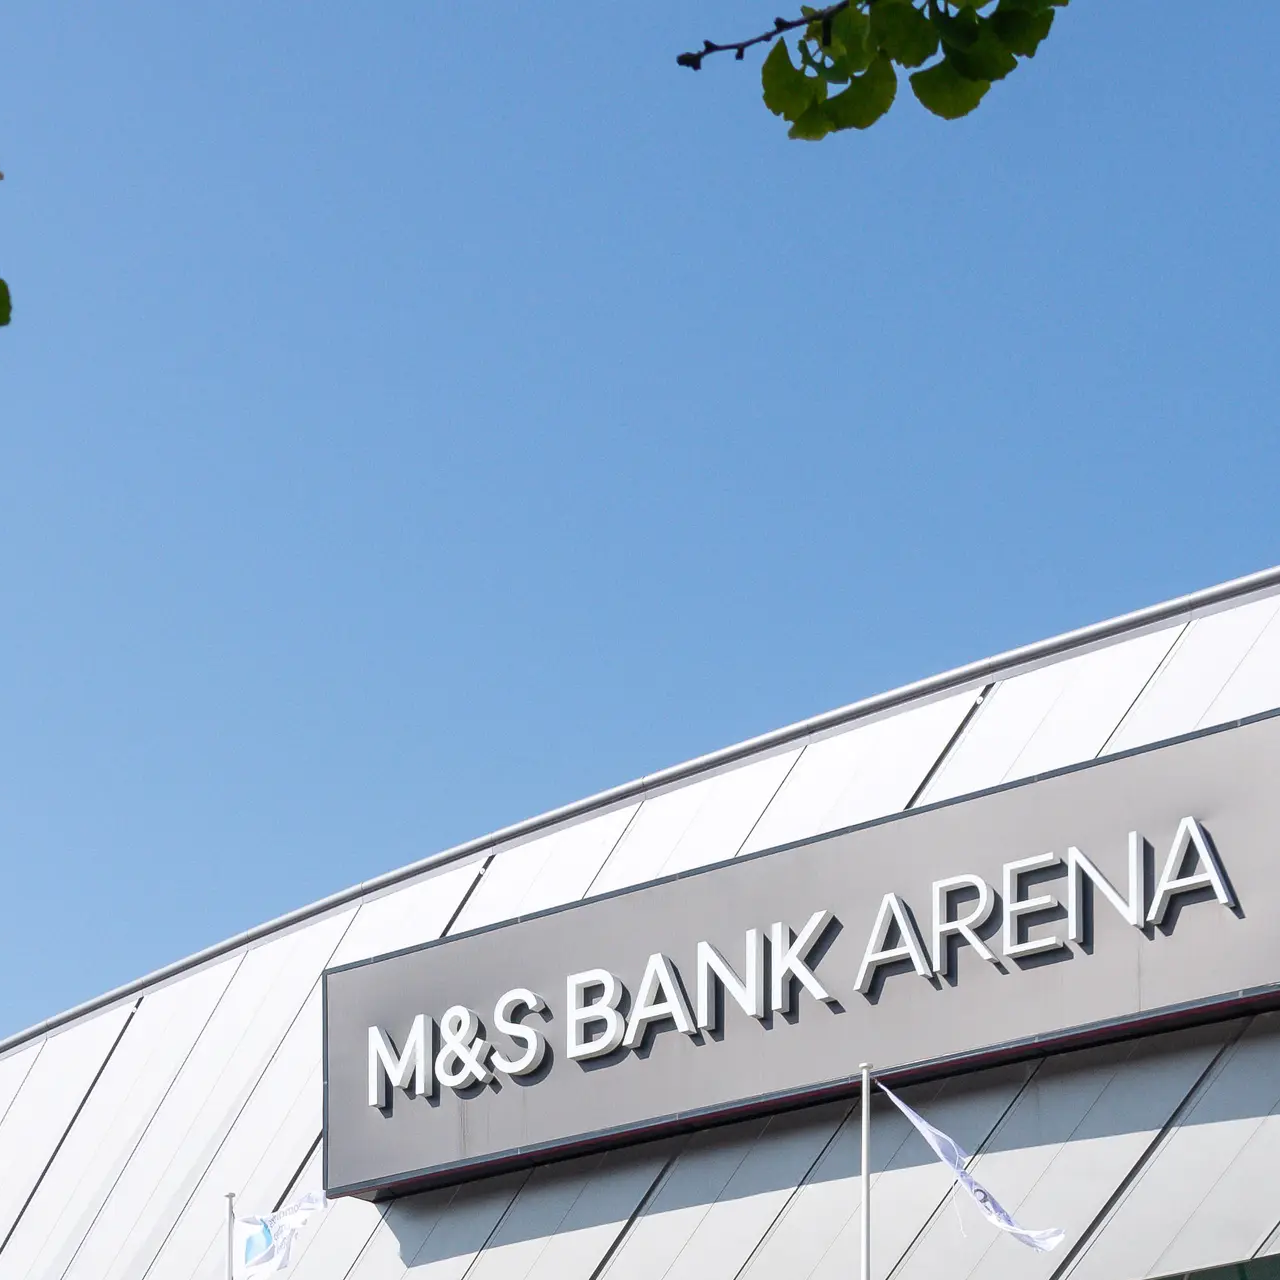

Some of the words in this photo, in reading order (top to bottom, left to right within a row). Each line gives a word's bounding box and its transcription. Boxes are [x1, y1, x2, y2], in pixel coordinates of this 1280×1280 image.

[367, 987, 548, 1109] M&S
[565, 908, 832, 1062] BANK
[854, 816, 1236, 994] ARENA
